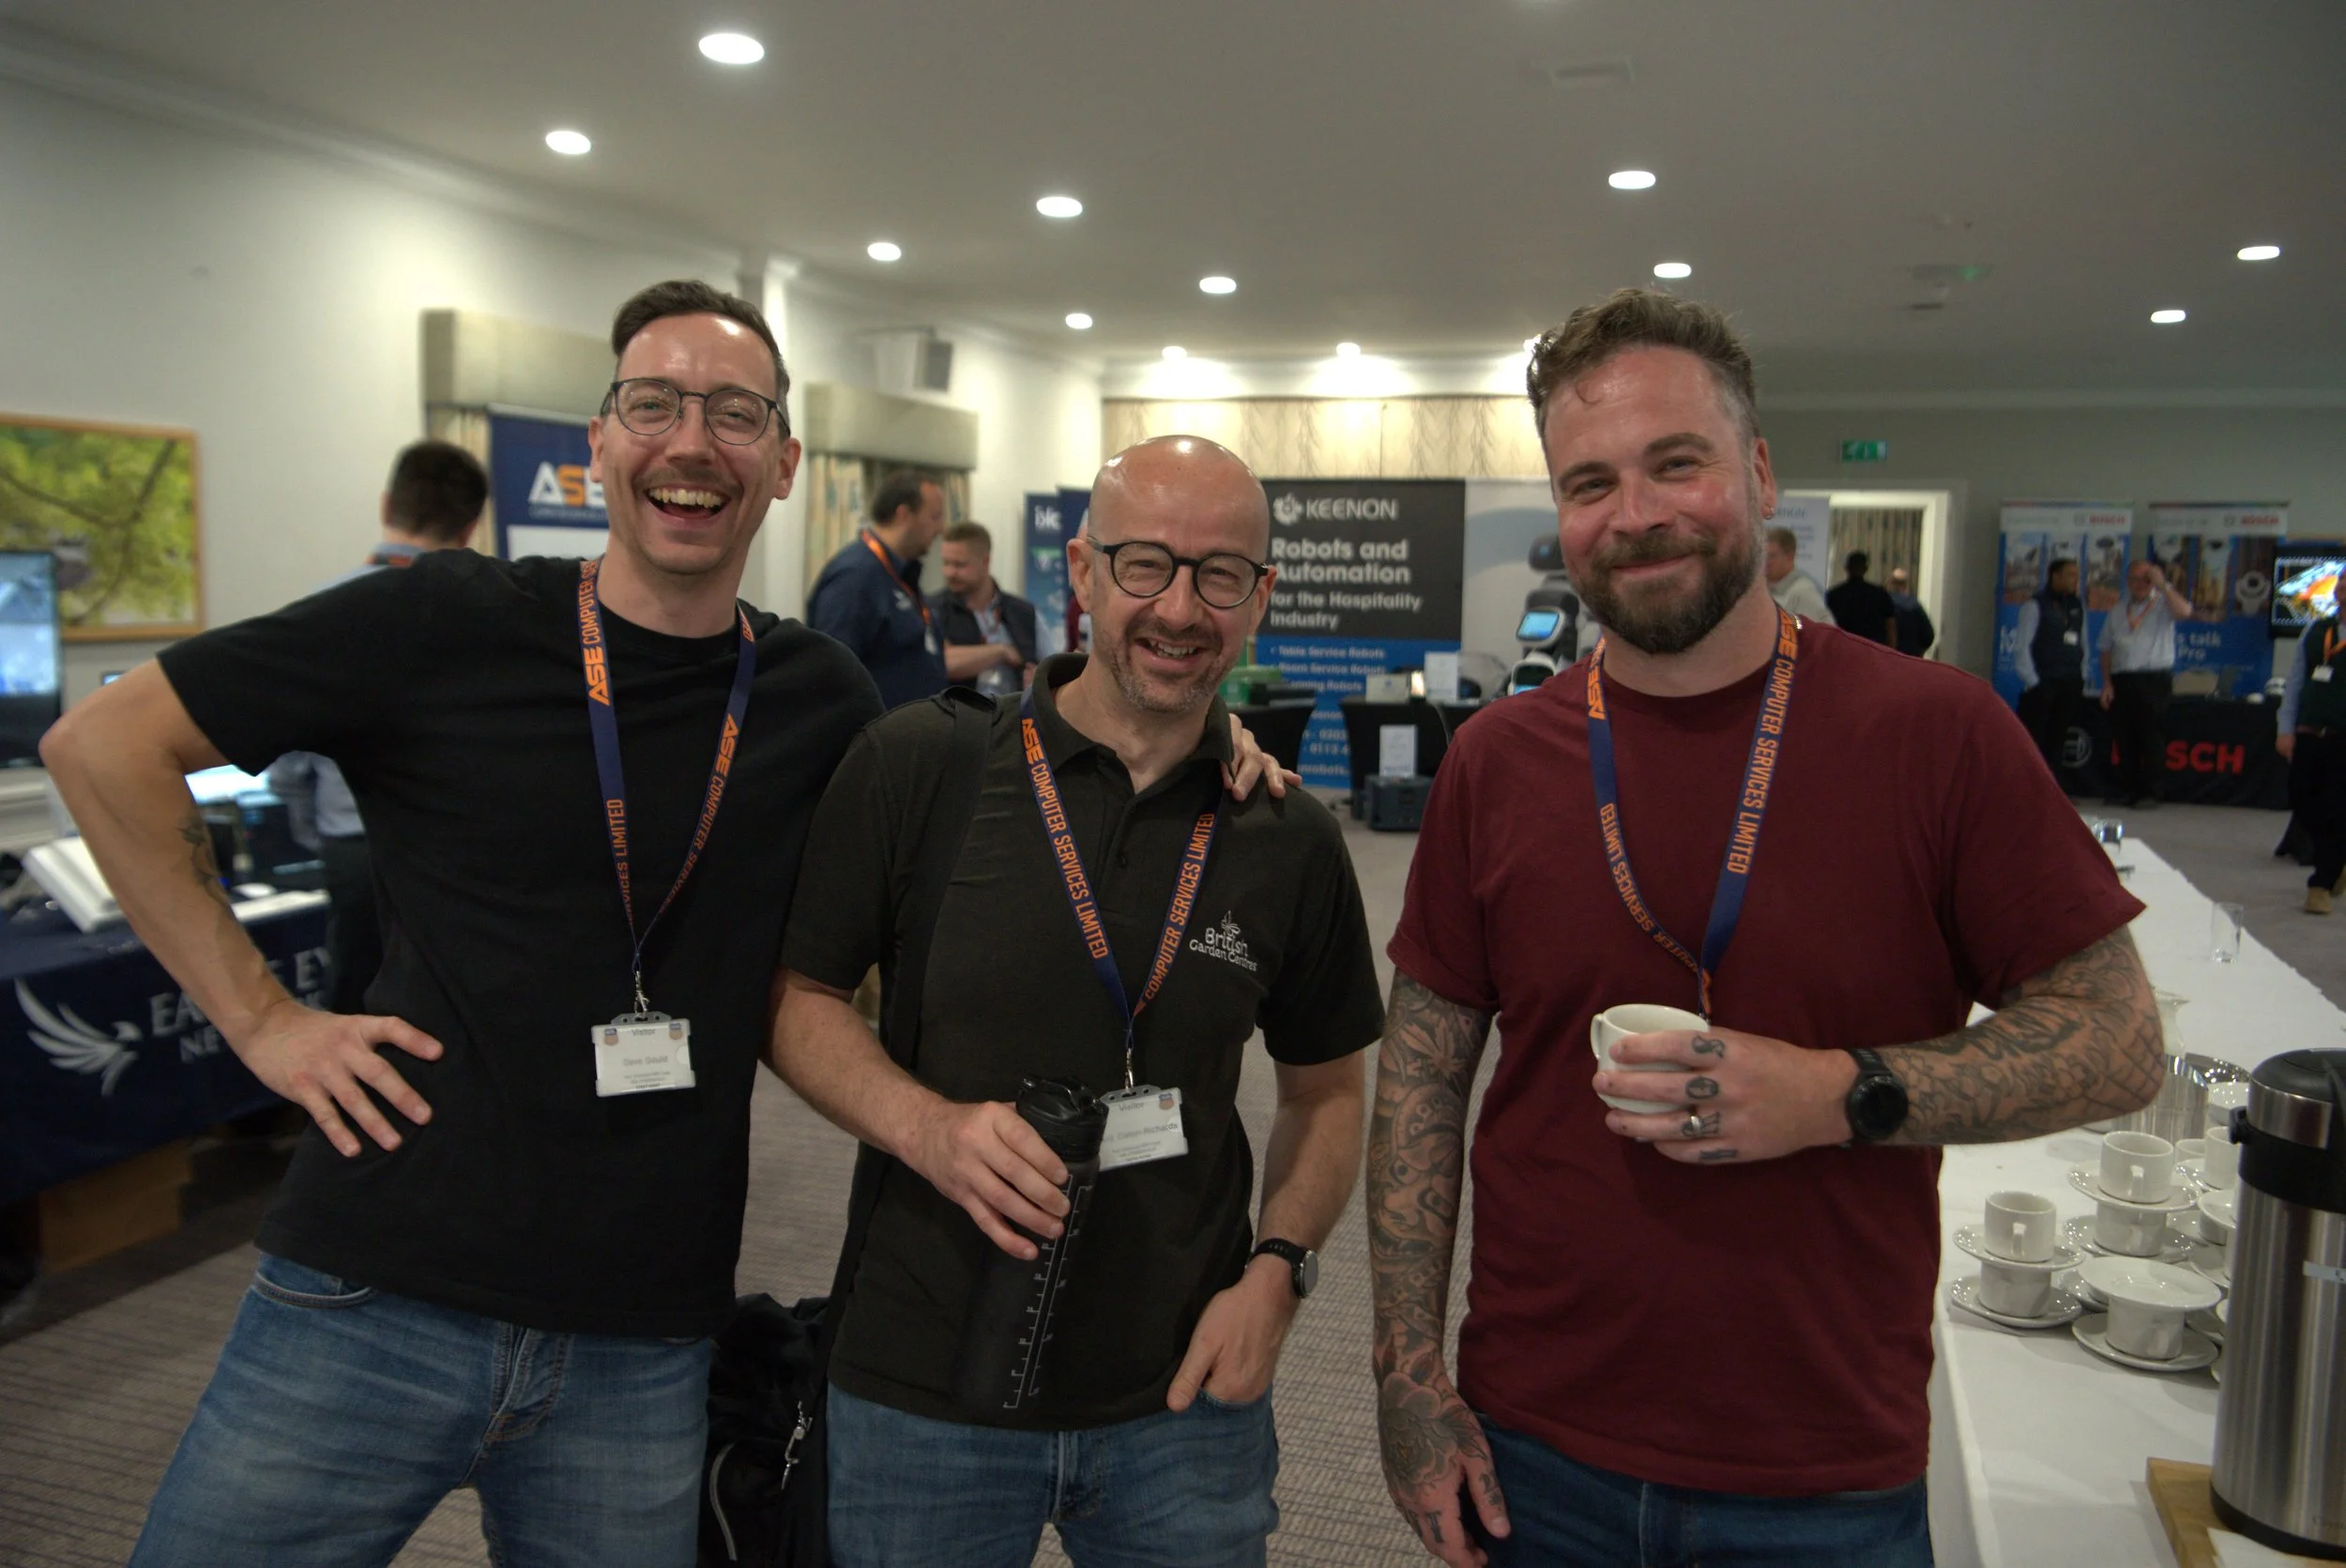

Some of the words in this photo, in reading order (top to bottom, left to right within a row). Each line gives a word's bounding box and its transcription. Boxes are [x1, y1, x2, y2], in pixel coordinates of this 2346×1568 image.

[1305, 498, 1399, 520] KEENON
[1272, 538, 1353, 559] Robots
[1359, 538, 1409, 560] and
[1275, 561, 1411, 583] Automation
[578, 574, 602, 646] COMPUTER
[1271, 590, 1293, 607] for
[1298, 590, 1324, 607] the
[1329, 591, 1423, 613] Hospitality
[1271, 612, 1339, 631] Industry
[584, 647, 611, 706] ASE
[1760, 658, 1795, 735] COMPUTER
[714, 712, 739, 778] ASE
[1022, 718, 1044, 765] ASE
[1031, 763, 1067, 833] COMPUTER
[1743, 737, 1778, 810] SERVICES
[606, 799, 629, 858] LIMITED
[693, 776, 724, 850] COMPUTER
[1600, 802, 1625, 862] LIMITED
[1054, 834, 1089, 901] SERVICES
[1727, 812, 1760, 875] LIMITED
[1145, 926, 1182, 999] COMPUTER
[1169, 861, 1201, 926] SERVICES
[1186, 813, 1215, 860] LIMITED
[1612, 860, 1654, 932] SERVICES
[1075, 901, 1108, 959] LIMITED
[1189, 939, 1227, 961] Garden
[1227, 951, 1257, 972] Centres
[1205, 927, 1249, 957] British
